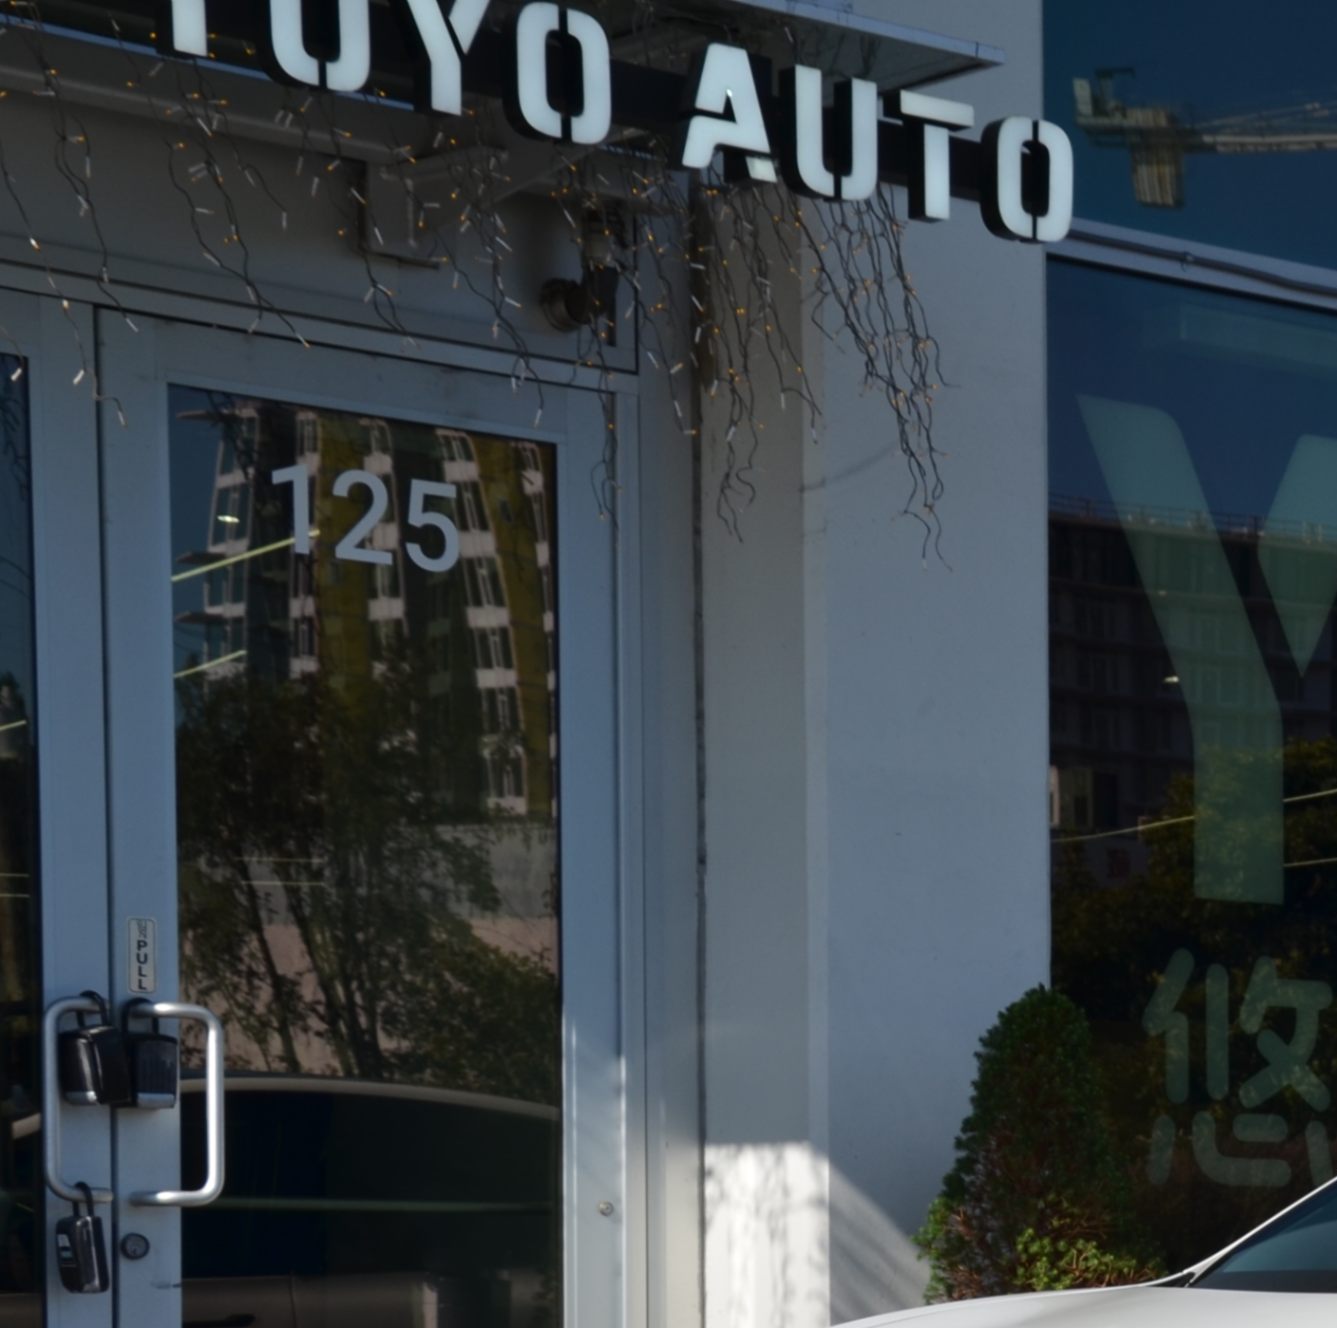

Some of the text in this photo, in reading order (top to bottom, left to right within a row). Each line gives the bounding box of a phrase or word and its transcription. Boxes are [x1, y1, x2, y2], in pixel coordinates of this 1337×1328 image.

[680, 42, 1074, 243] AUTO
[271, 465, 461, 573] 125
[136, 939, 148, 991] PULL
